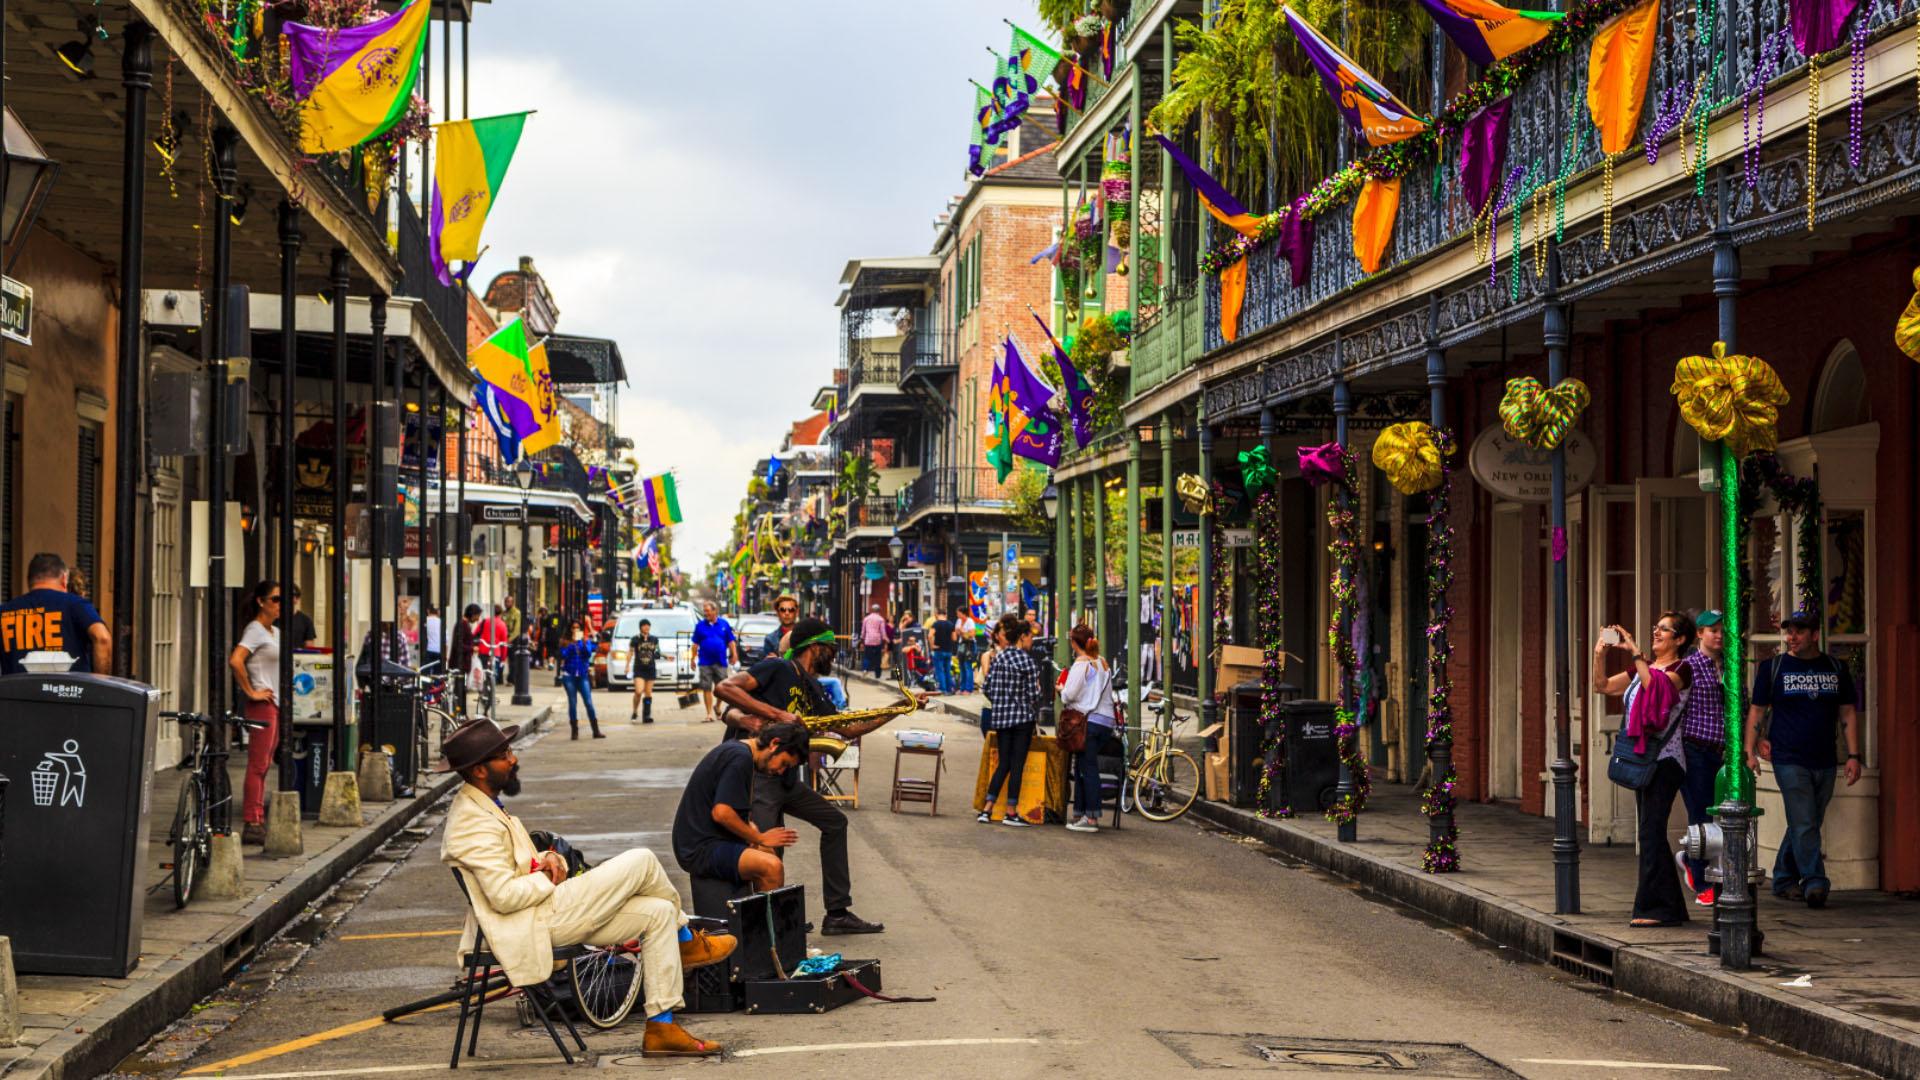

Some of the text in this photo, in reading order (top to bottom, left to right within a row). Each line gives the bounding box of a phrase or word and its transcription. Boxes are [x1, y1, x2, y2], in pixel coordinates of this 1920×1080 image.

[1, 295, 25, 332] Royal
[1491, 471, 1518, 481] NEW
[1, 611, 64, 653] FIRE
[1783, 674, 1839, 685] SPORTING
[42, 683, 84, 694] BigBelly
[1784, 683, 1819, 691] KANSAS
[1820, 683, 1839, 693] CITY
